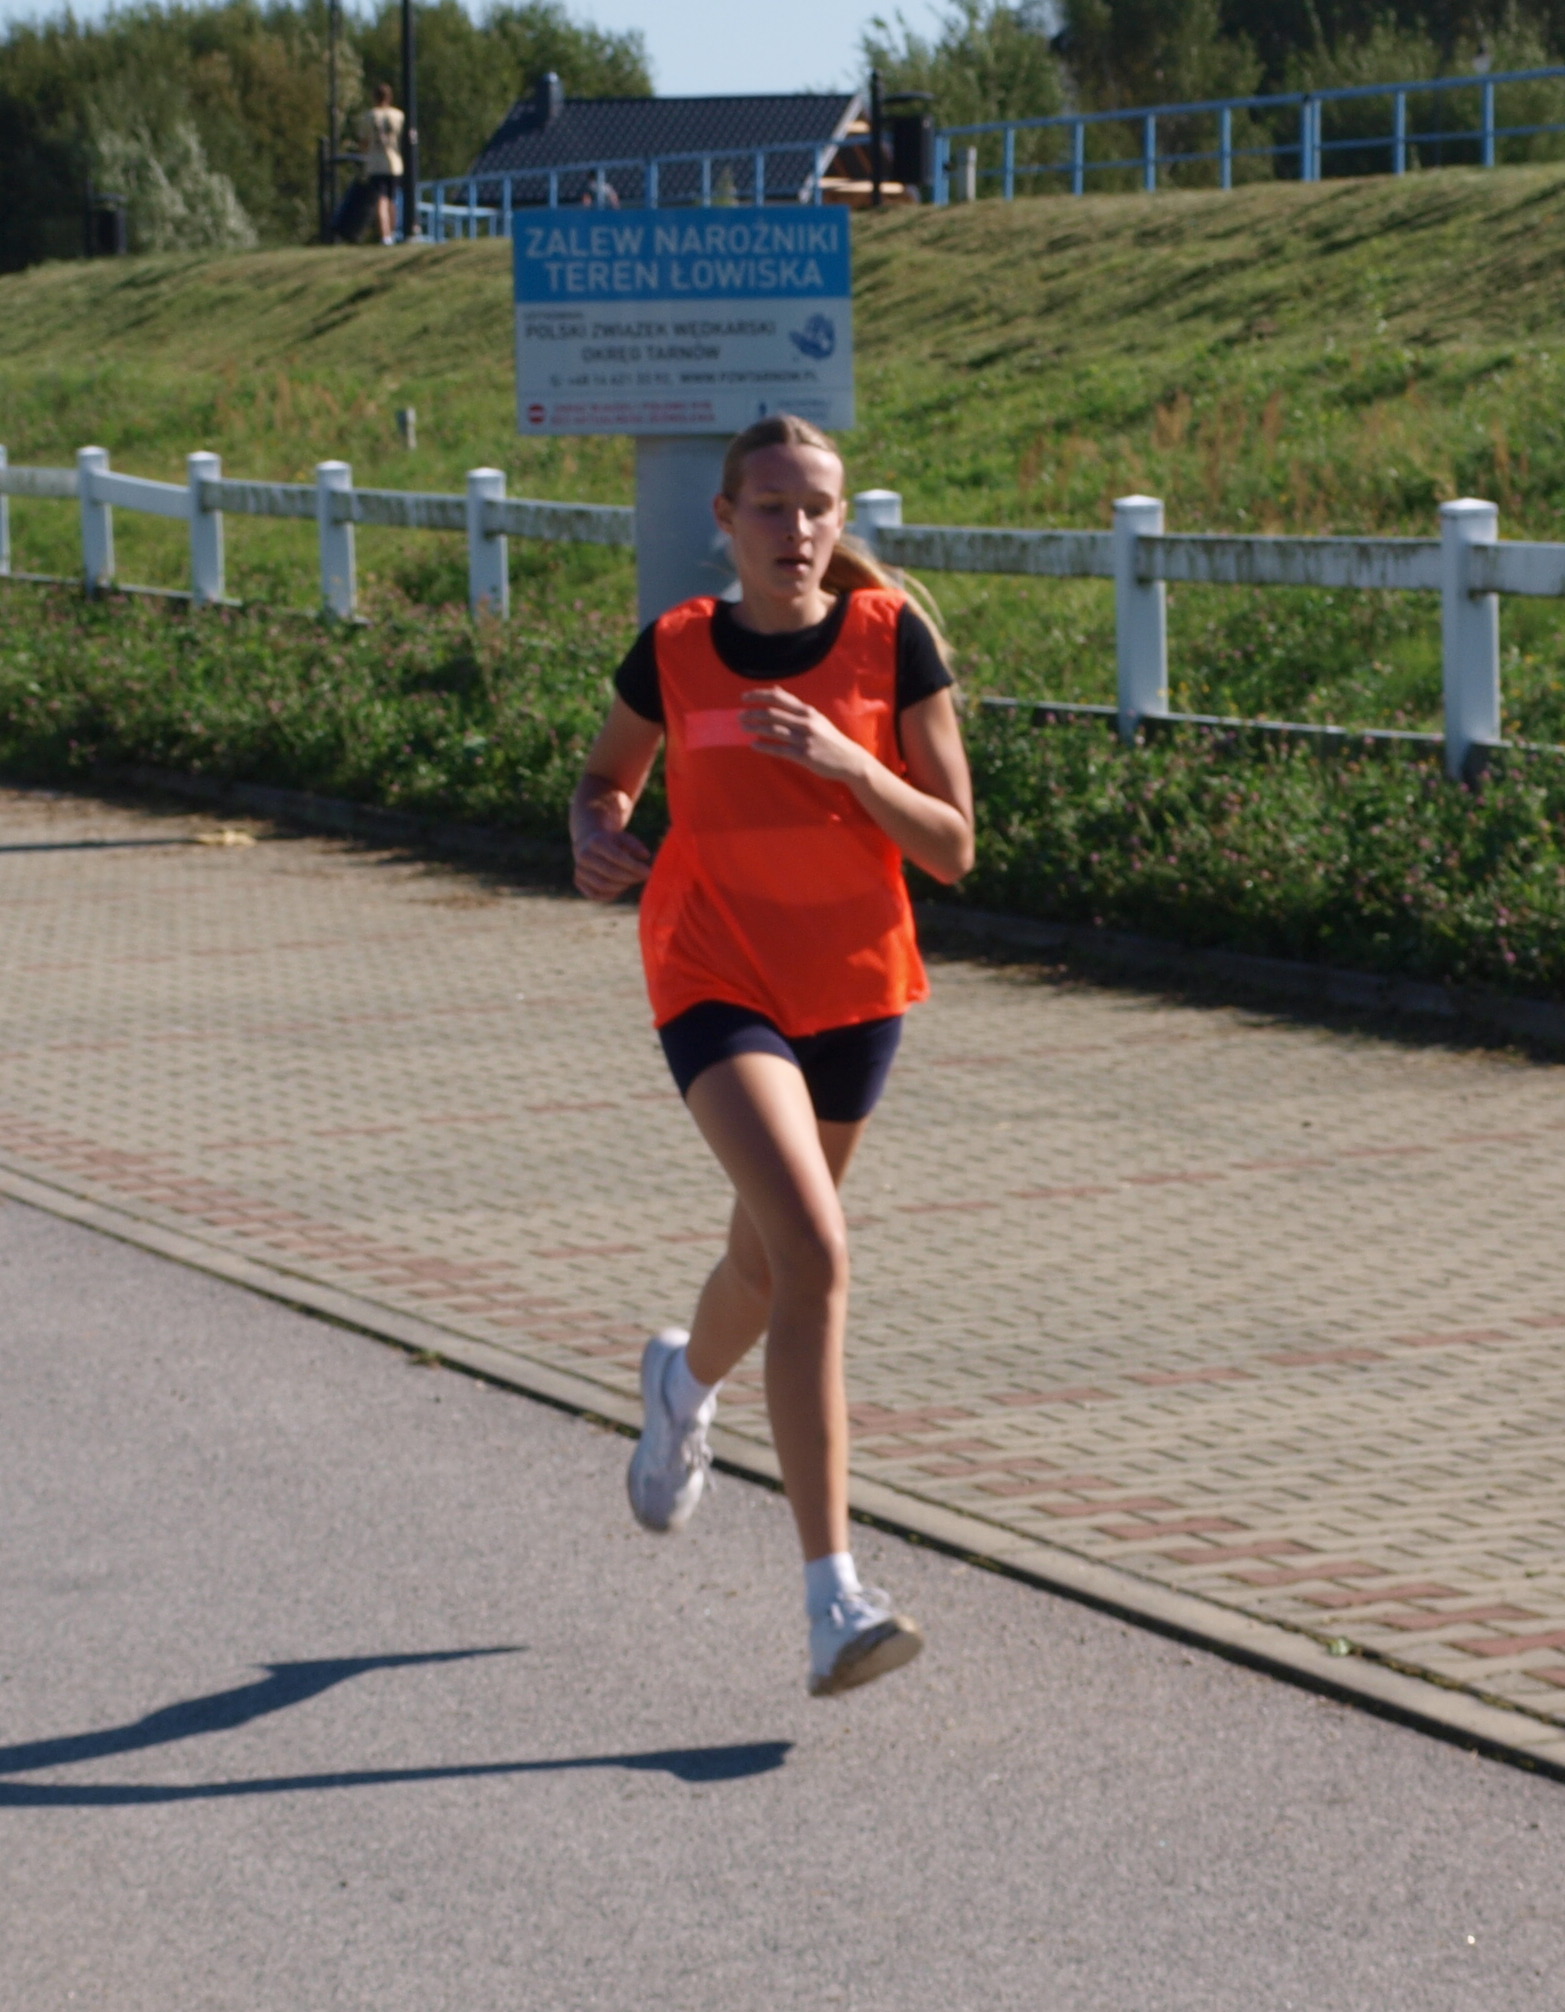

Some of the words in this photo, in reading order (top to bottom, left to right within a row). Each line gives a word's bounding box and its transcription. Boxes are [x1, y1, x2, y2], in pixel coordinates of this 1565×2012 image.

[525, 226, 645, 258] ZALEW
[655, 220, 839, 256] NAROŻNIKI
[546, 261, 659, 292] TEREN
[670, 258, 824, 291] ŁOWISKA
[526, 322, 586, 340] POLSKI
[646, 342, 720, 361] TARNÓW
